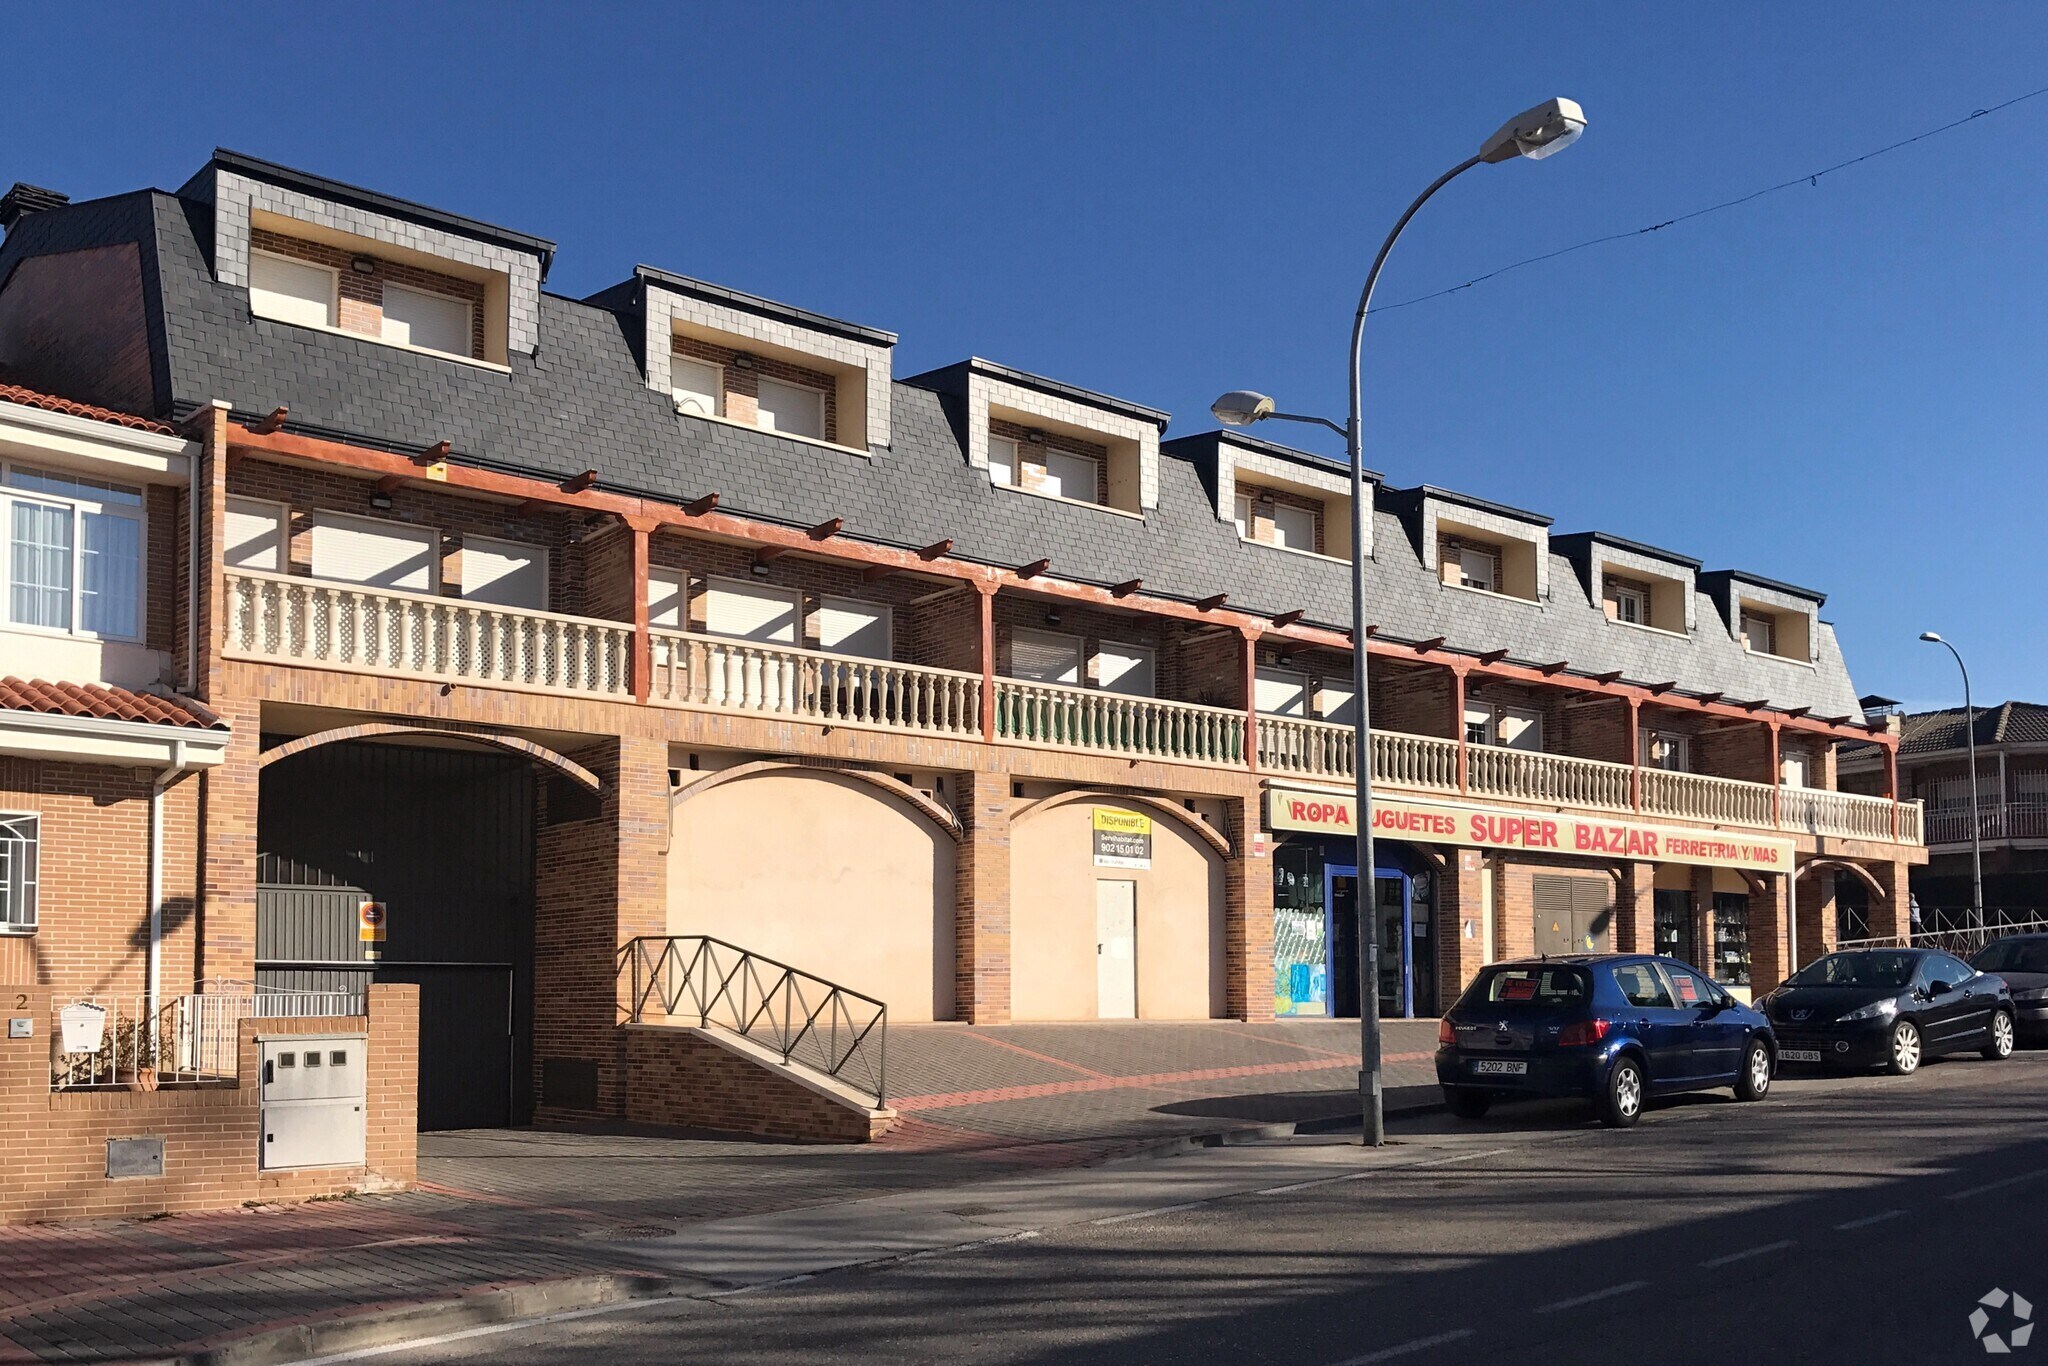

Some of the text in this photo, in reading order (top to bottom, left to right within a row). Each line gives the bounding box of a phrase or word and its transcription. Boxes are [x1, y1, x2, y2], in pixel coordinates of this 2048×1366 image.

[1101, 814, 1145, 828] DISPONIBLE
[1292, 801, 1778, 863] ROPA UGUETES SUPER BAZAR FERRETERIA Y MAS
[1101, 843, 1144, 855] 902 15 01 02
[16, 994, 28, 1010] 2
[1781, 1051, 1801, 1060] 1620
[1480, 1062, 1524, 1073] 5202 BNF
